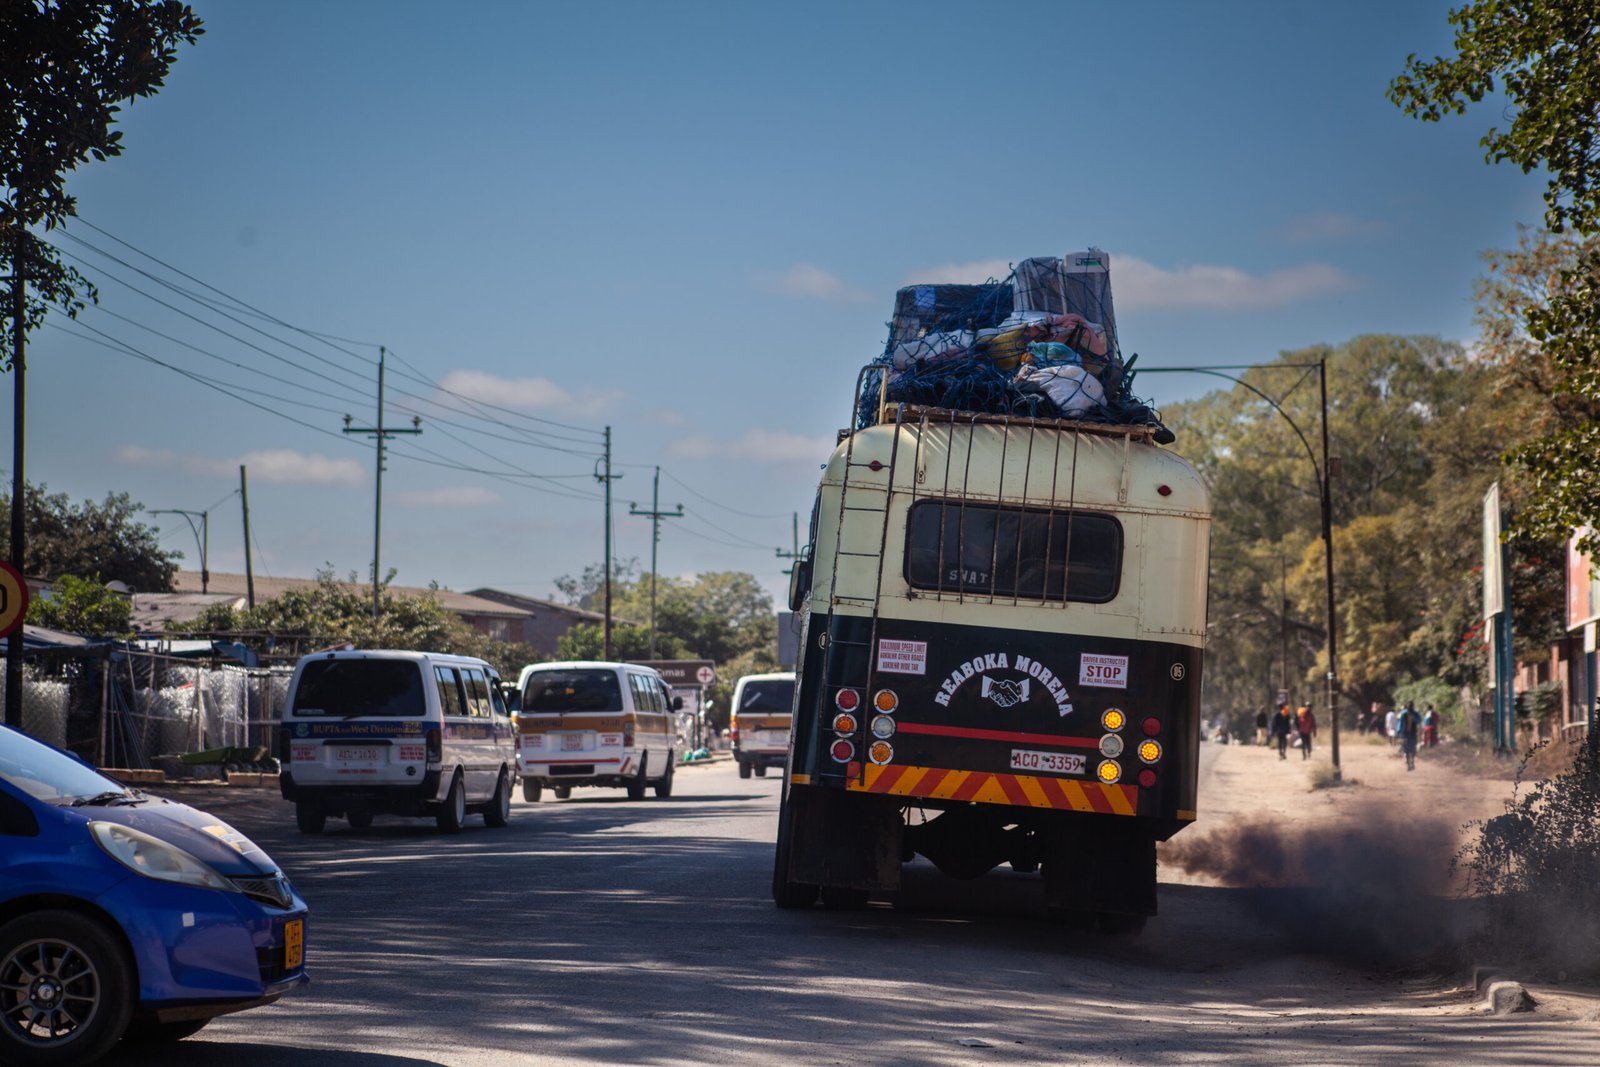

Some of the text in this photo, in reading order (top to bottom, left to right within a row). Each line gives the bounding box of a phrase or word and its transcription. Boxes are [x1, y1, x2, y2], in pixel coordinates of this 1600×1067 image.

[949, 570, 988, 584] SWAT
[902, 642, 913, 652] SPEED
[1099, 657, 1126, 666] INSTRUCTED
[1087, 666, 1121, 678] STOP
[934, 652, 1074, 717] REABOKA MORENA
[351, 724, 369, 734] West
[371, 724, 402, 734] Division
[1014, 752, 1081, 771] ACQ 3359
